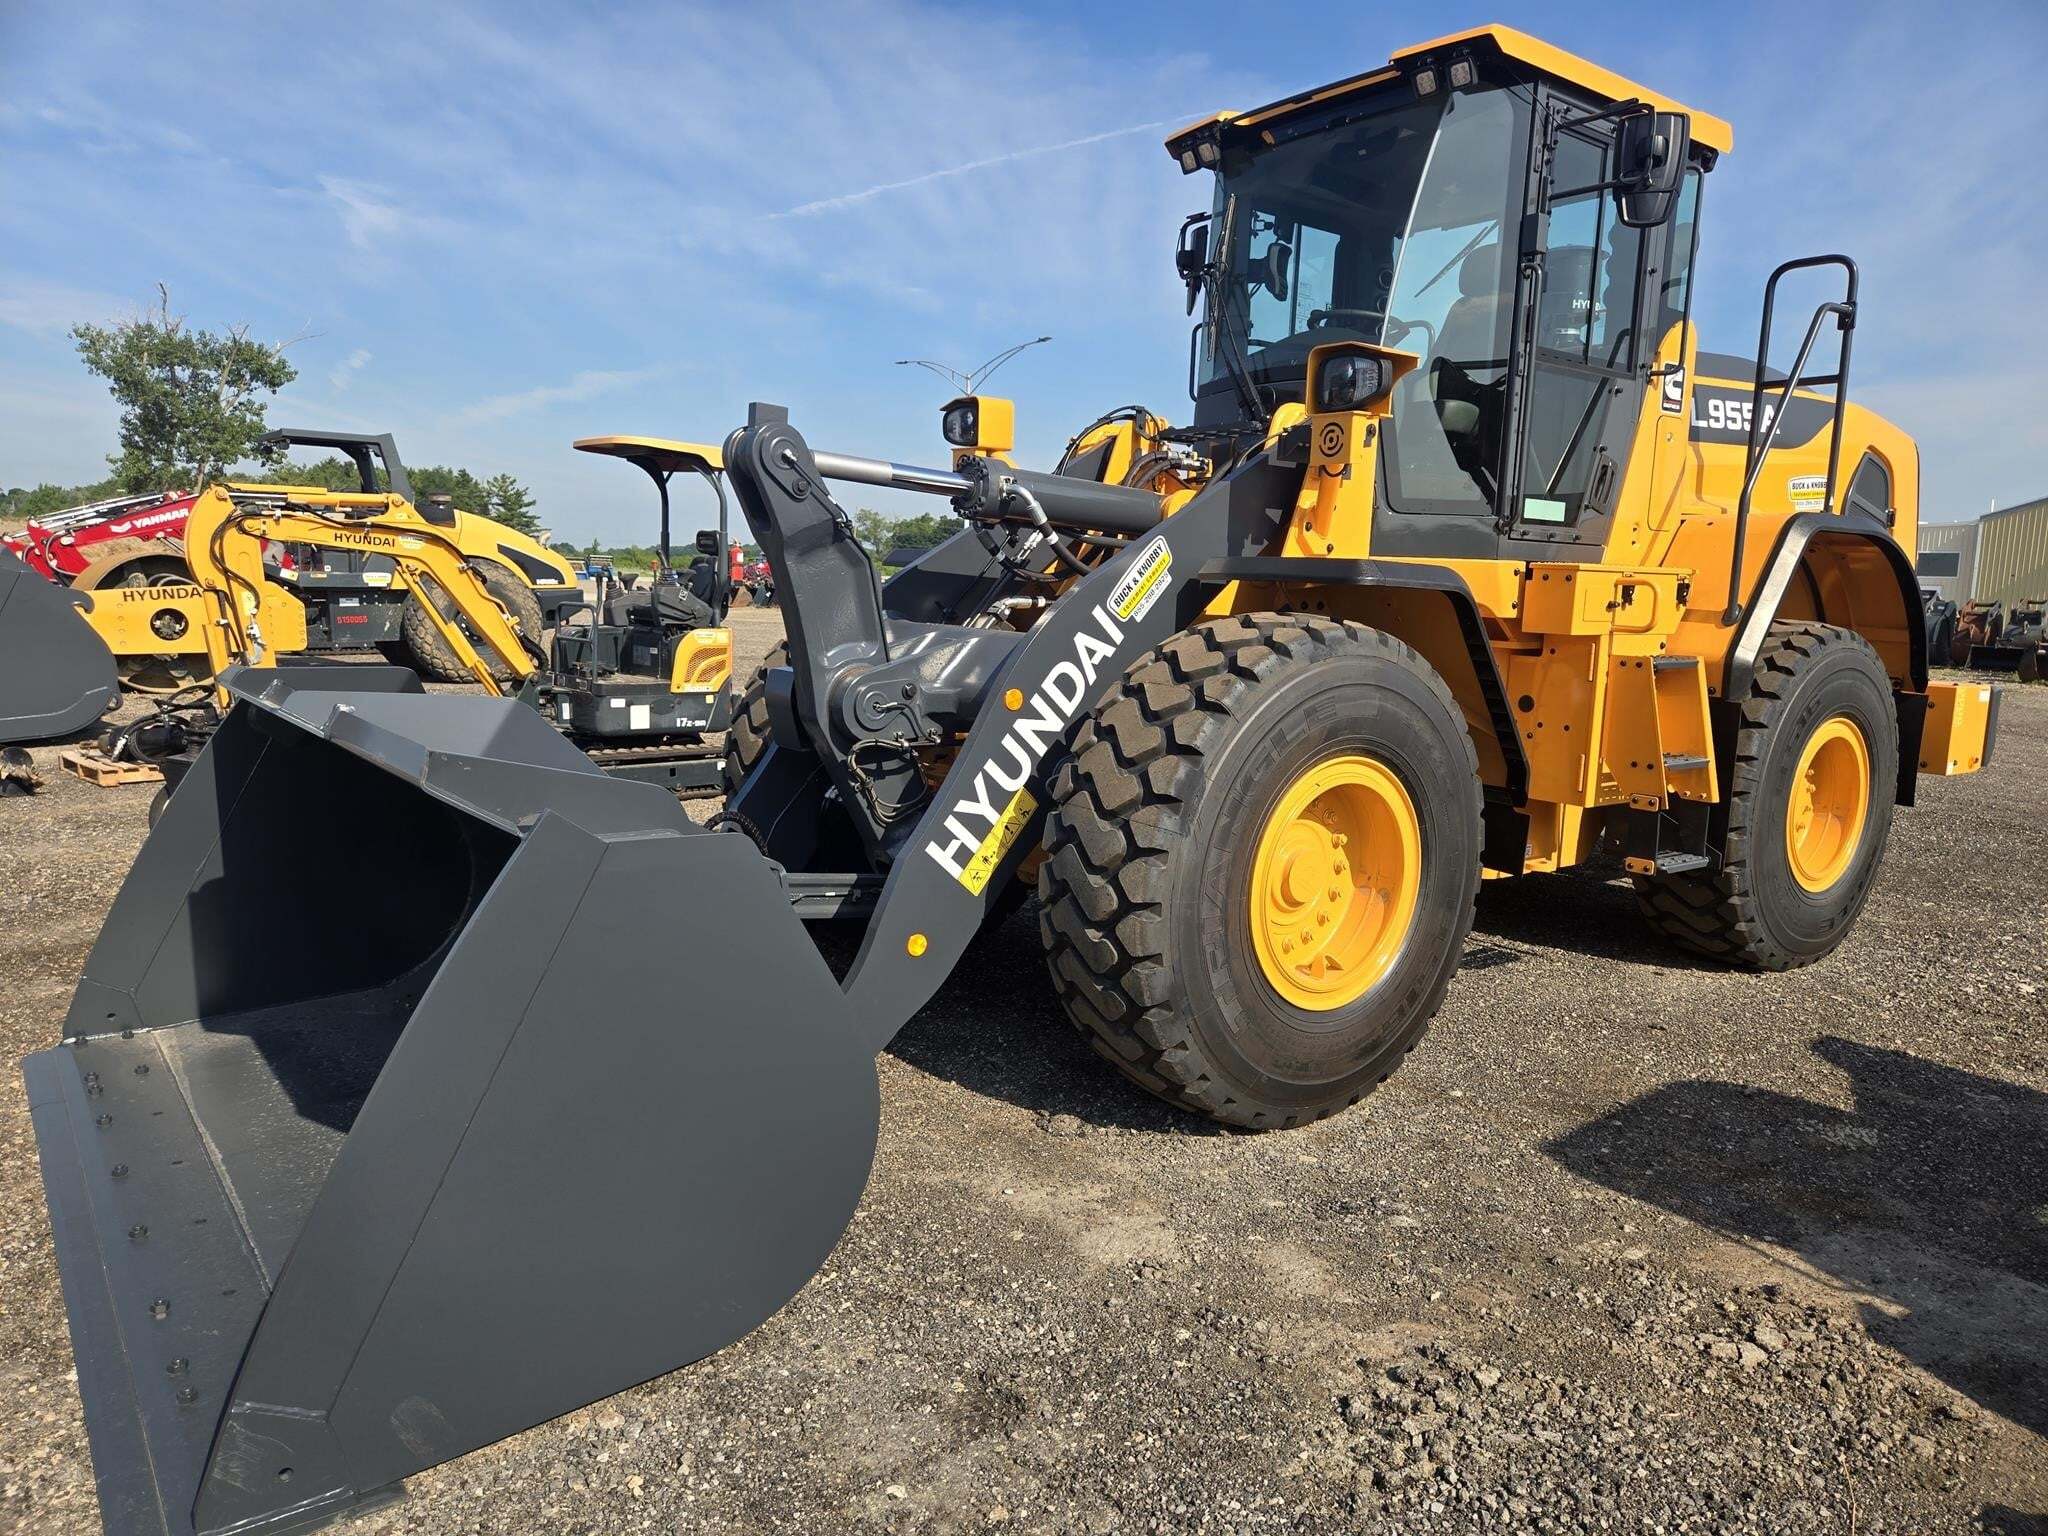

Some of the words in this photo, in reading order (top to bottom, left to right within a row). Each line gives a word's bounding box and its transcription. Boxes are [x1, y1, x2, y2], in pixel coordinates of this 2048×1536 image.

[132, 508, 189, 528] YANMAR
[334, 532, 396, 548] HYUNDAI
[1113, 583, 1134, 608] BUCK
[1133, 577, 1140, 586] &
[1137, 543, 1163, 578] KNOBBY
[122, 587, 203, 602] HYUNDA
[925, 604, 1125, 882] HYUNDAI
